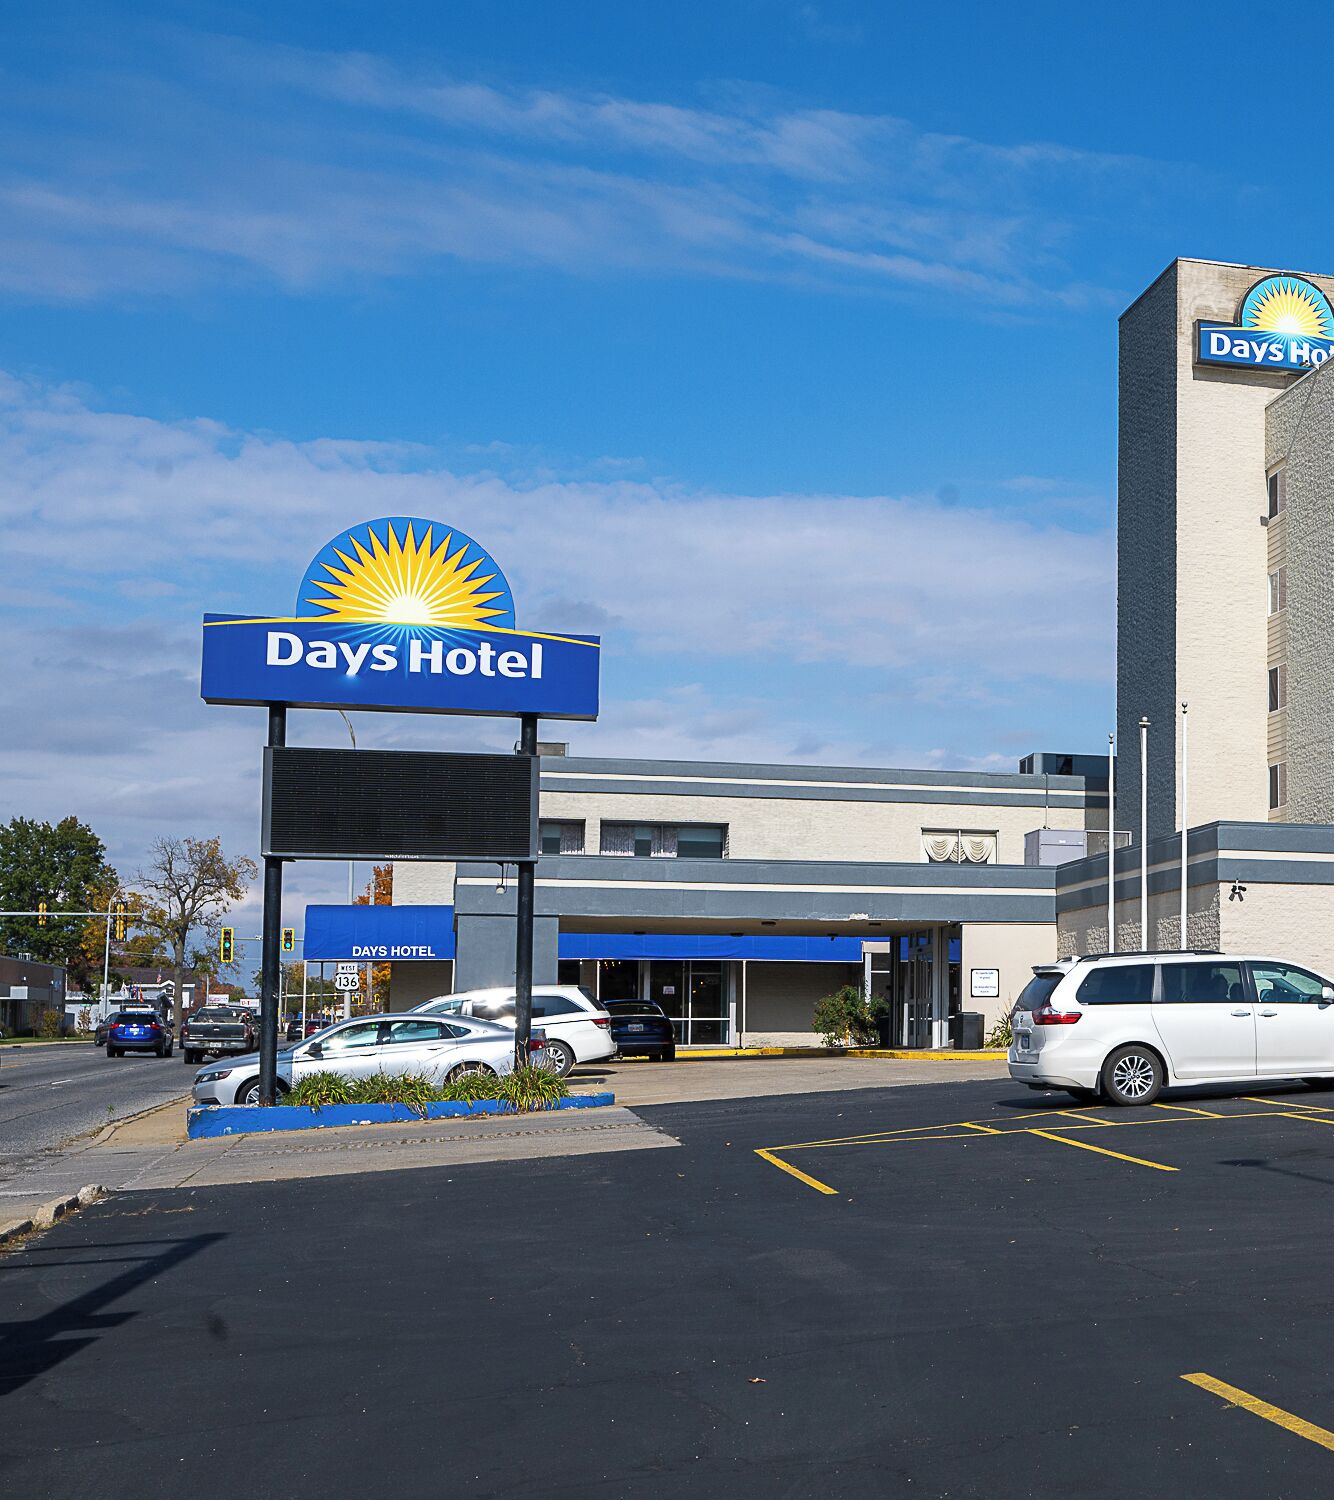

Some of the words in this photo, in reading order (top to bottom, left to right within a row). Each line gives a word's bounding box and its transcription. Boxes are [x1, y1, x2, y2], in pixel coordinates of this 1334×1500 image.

[1210, 332, 1284, 363] Days
[266, 631, 398, 676] Days
[409, 639, 543, 679] Hotel
[352, 946, 388, 957] DAYS
[391, 946, 435, 957] HOTEL
[338, 976, 357, 987] 136
